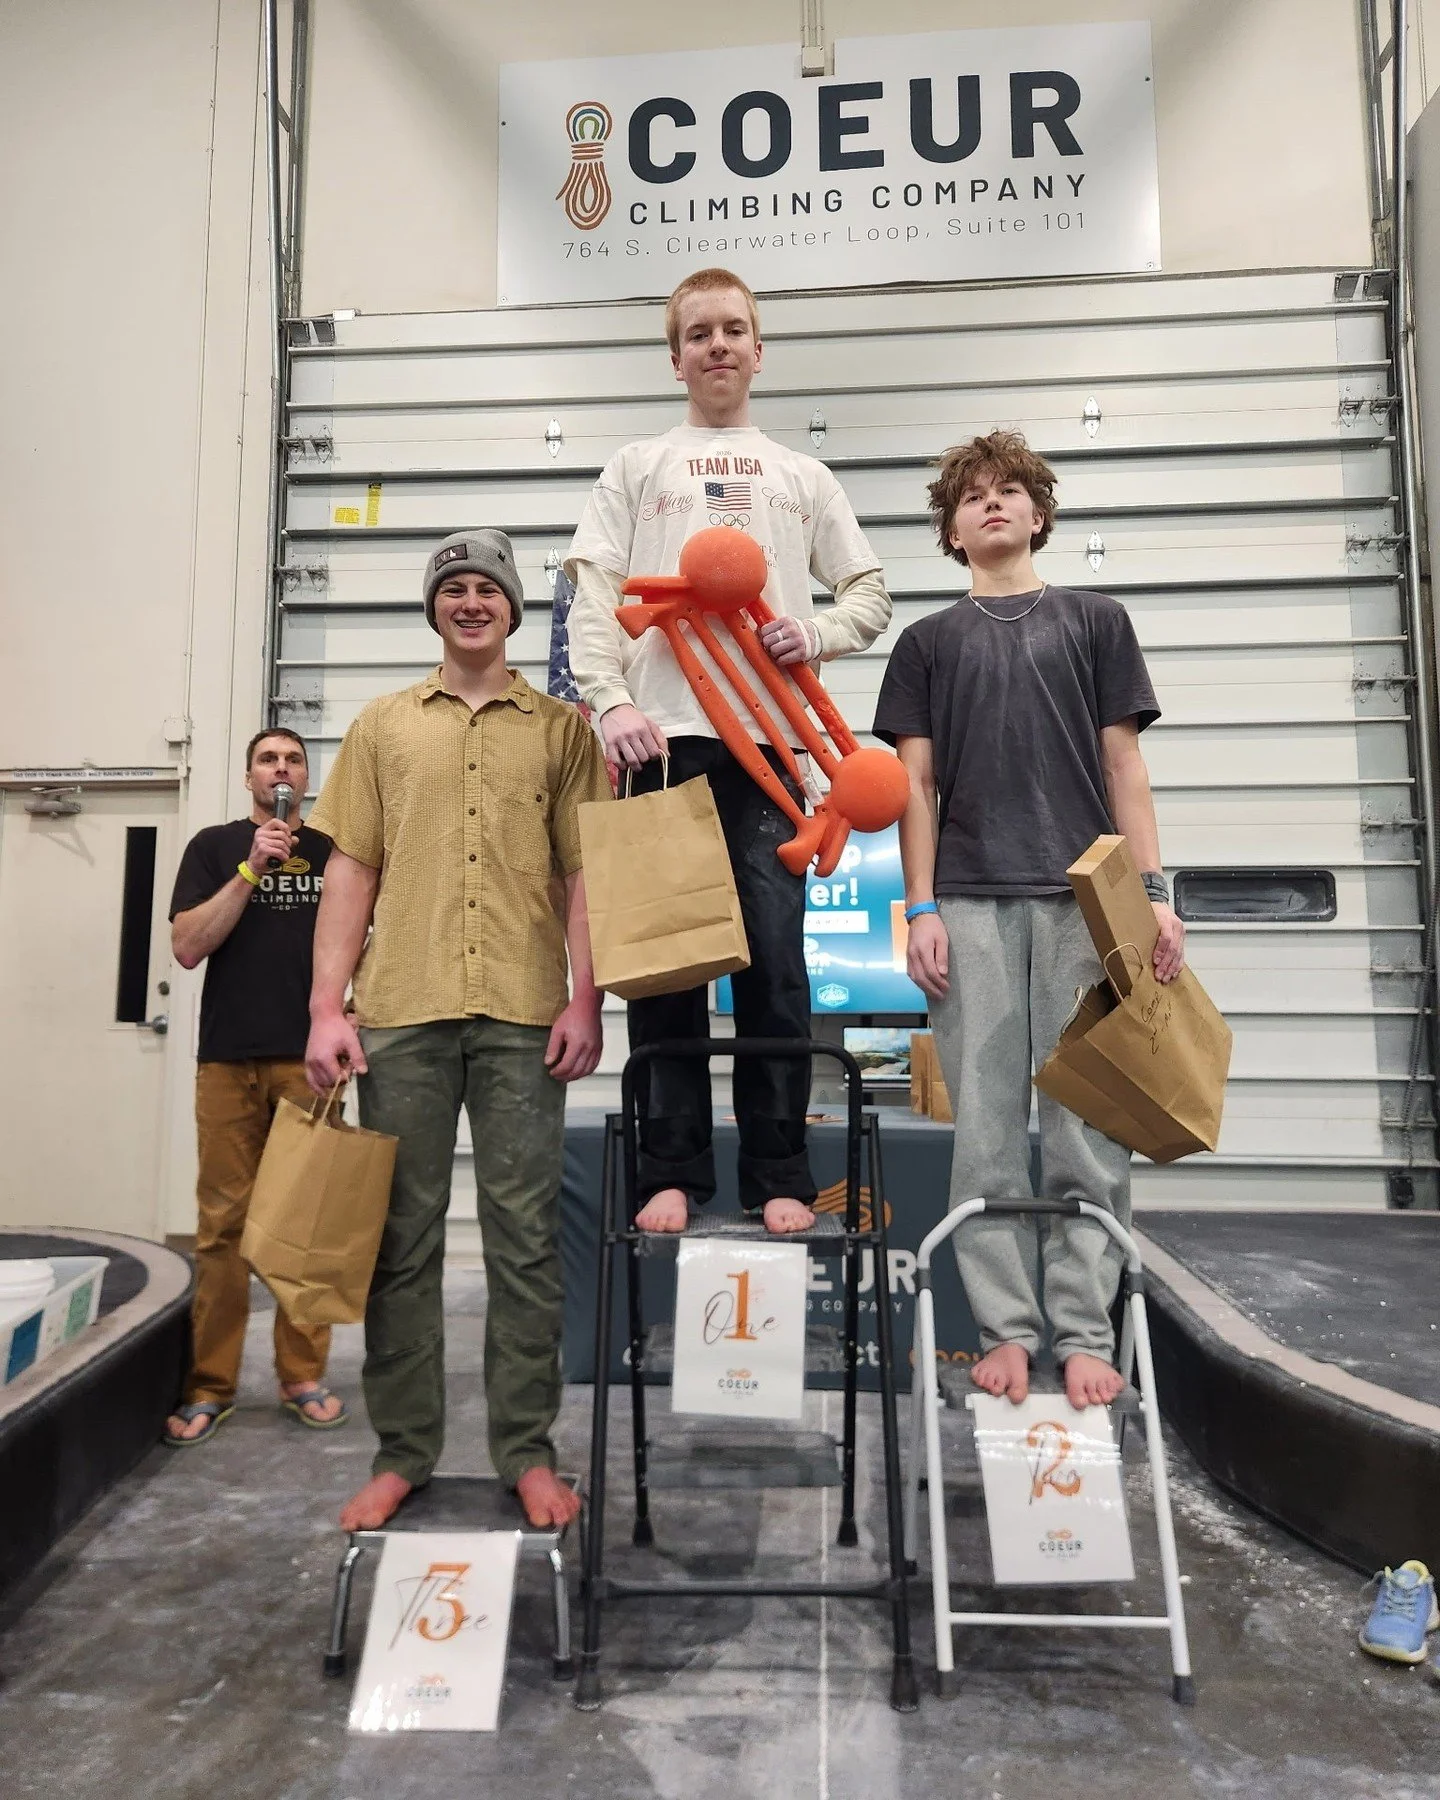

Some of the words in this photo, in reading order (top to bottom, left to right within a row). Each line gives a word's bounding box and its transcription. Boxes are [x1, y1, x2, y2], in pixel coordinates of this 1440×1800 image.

[627, 71, 1084, 184] COEUR
[629, 189, 842, 225] CLIMBING
[872, 173, 1085, 209] COMPANY
[563, 240, 610, 259] 764
[625, 239, 650, 256] S.
[666, 229, 832, 254] Clearwater
[848, 224, 930, 243] Loop,
[947, 216, 1026, 236] Suite
[1043, 212, 1085, 231] 101
[687, 457, 729, 476] TEAM
[734, 457, 763, 476] USA
[251, 894, 319, 903] CLIMBING
[259, 875, 323, 892] OEUR
[724, 1269, 758, 1341] 1
[821, 1300, 904, 1314] COPAY
[717, 1378, 759, 1389] COEUR
[418, 1562, 473, 1641] 3
